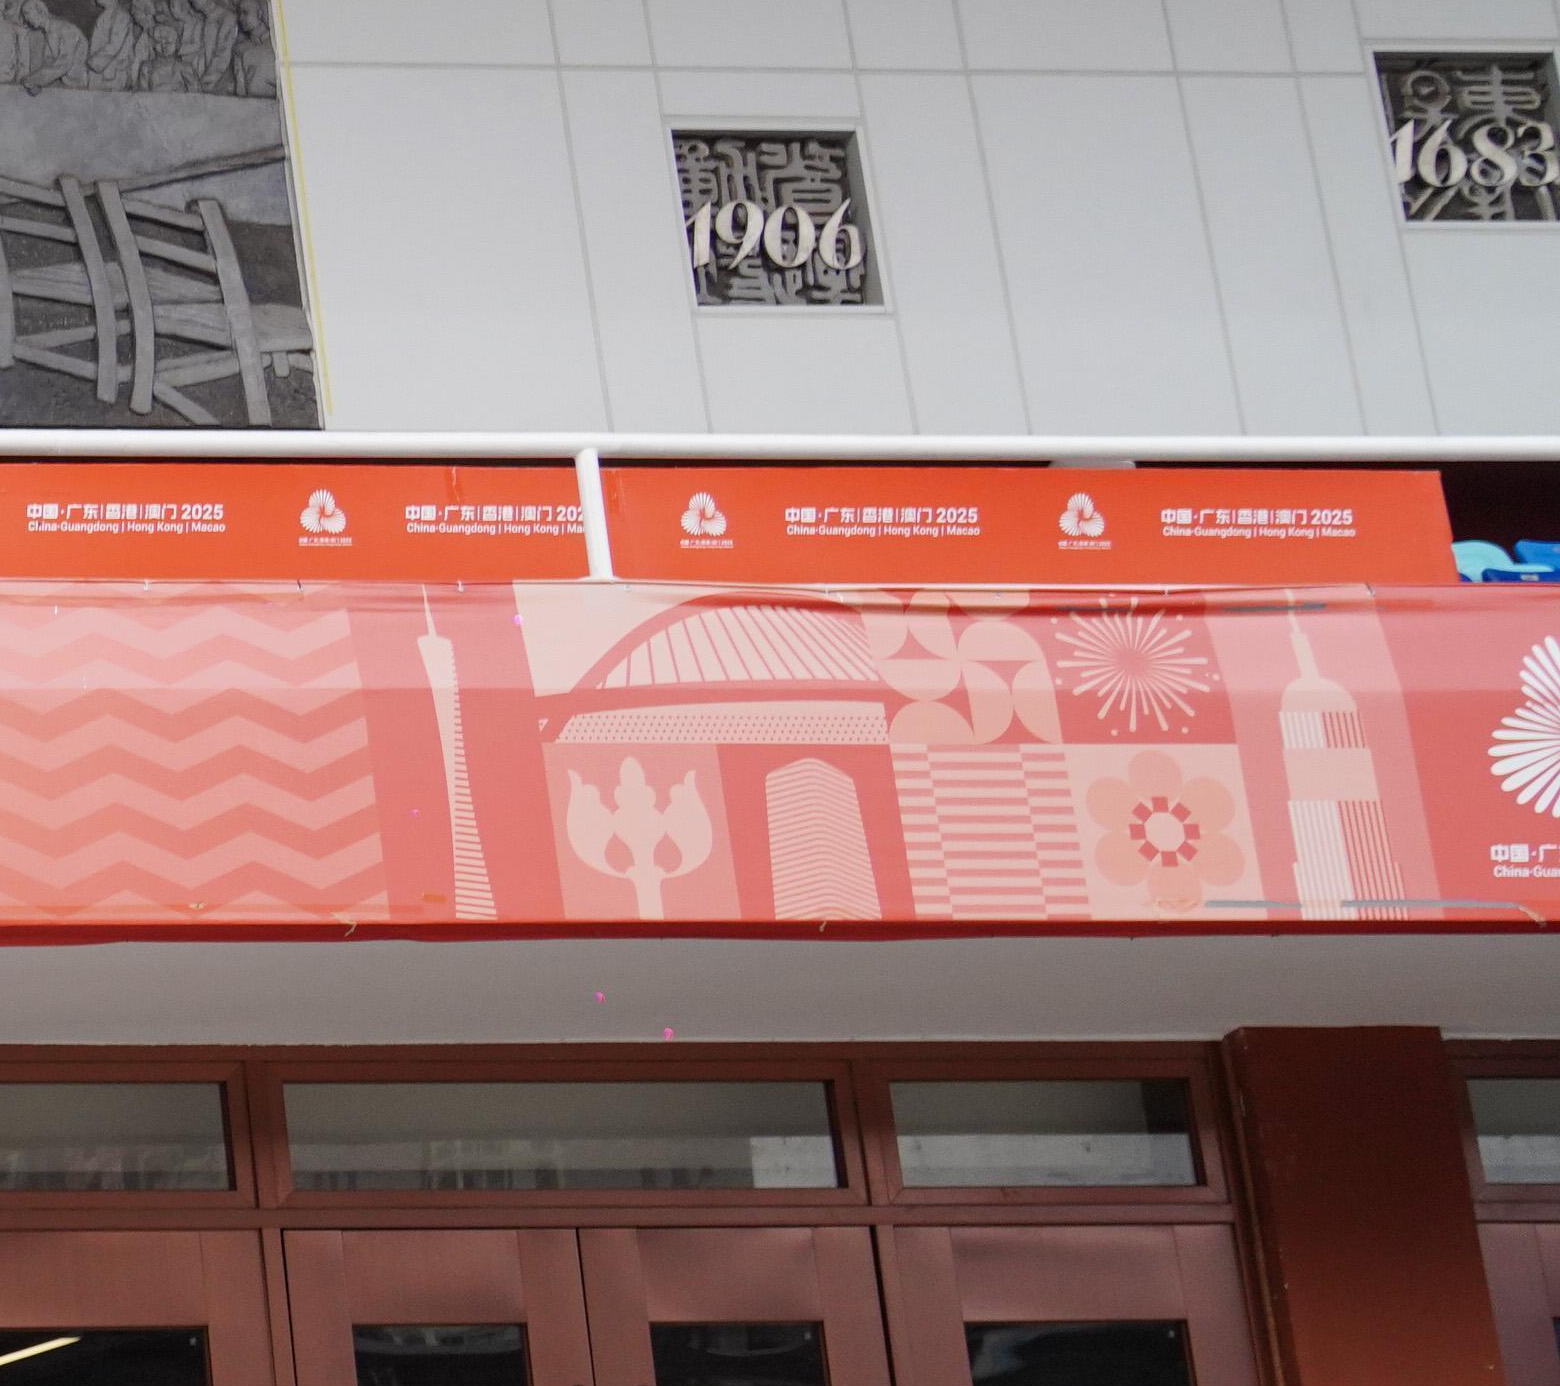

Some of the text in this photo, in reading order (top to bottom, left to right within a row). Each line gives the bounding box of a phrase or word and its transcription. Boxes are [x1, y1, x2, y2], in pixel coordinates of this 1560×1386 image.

[1389, 118, 1560, 188] 1683
[685, 197, 863, 271] 1906
[181, 504, 223, 519] 2025
[937, 507, 978, 523] 2025
[1312, 509, 1353, 525] 2025
[128, 522, 153, 533] Hong
[157, 522, 182, 534] Kong
[192, 522, 225, 532] Macao
[506, 524, 531, 535] Hong
[535, 524, 559, 535] Kong
[885, 525, 910, 537] Hong
[913, 525, 938, 537] Kong
[947, 525, 980, 535] Macao
[1261, 527, 1286, 538] Hong
[1289, 527, 1314, 539] Kong
[1323, 527, 1356, 537] Macao
